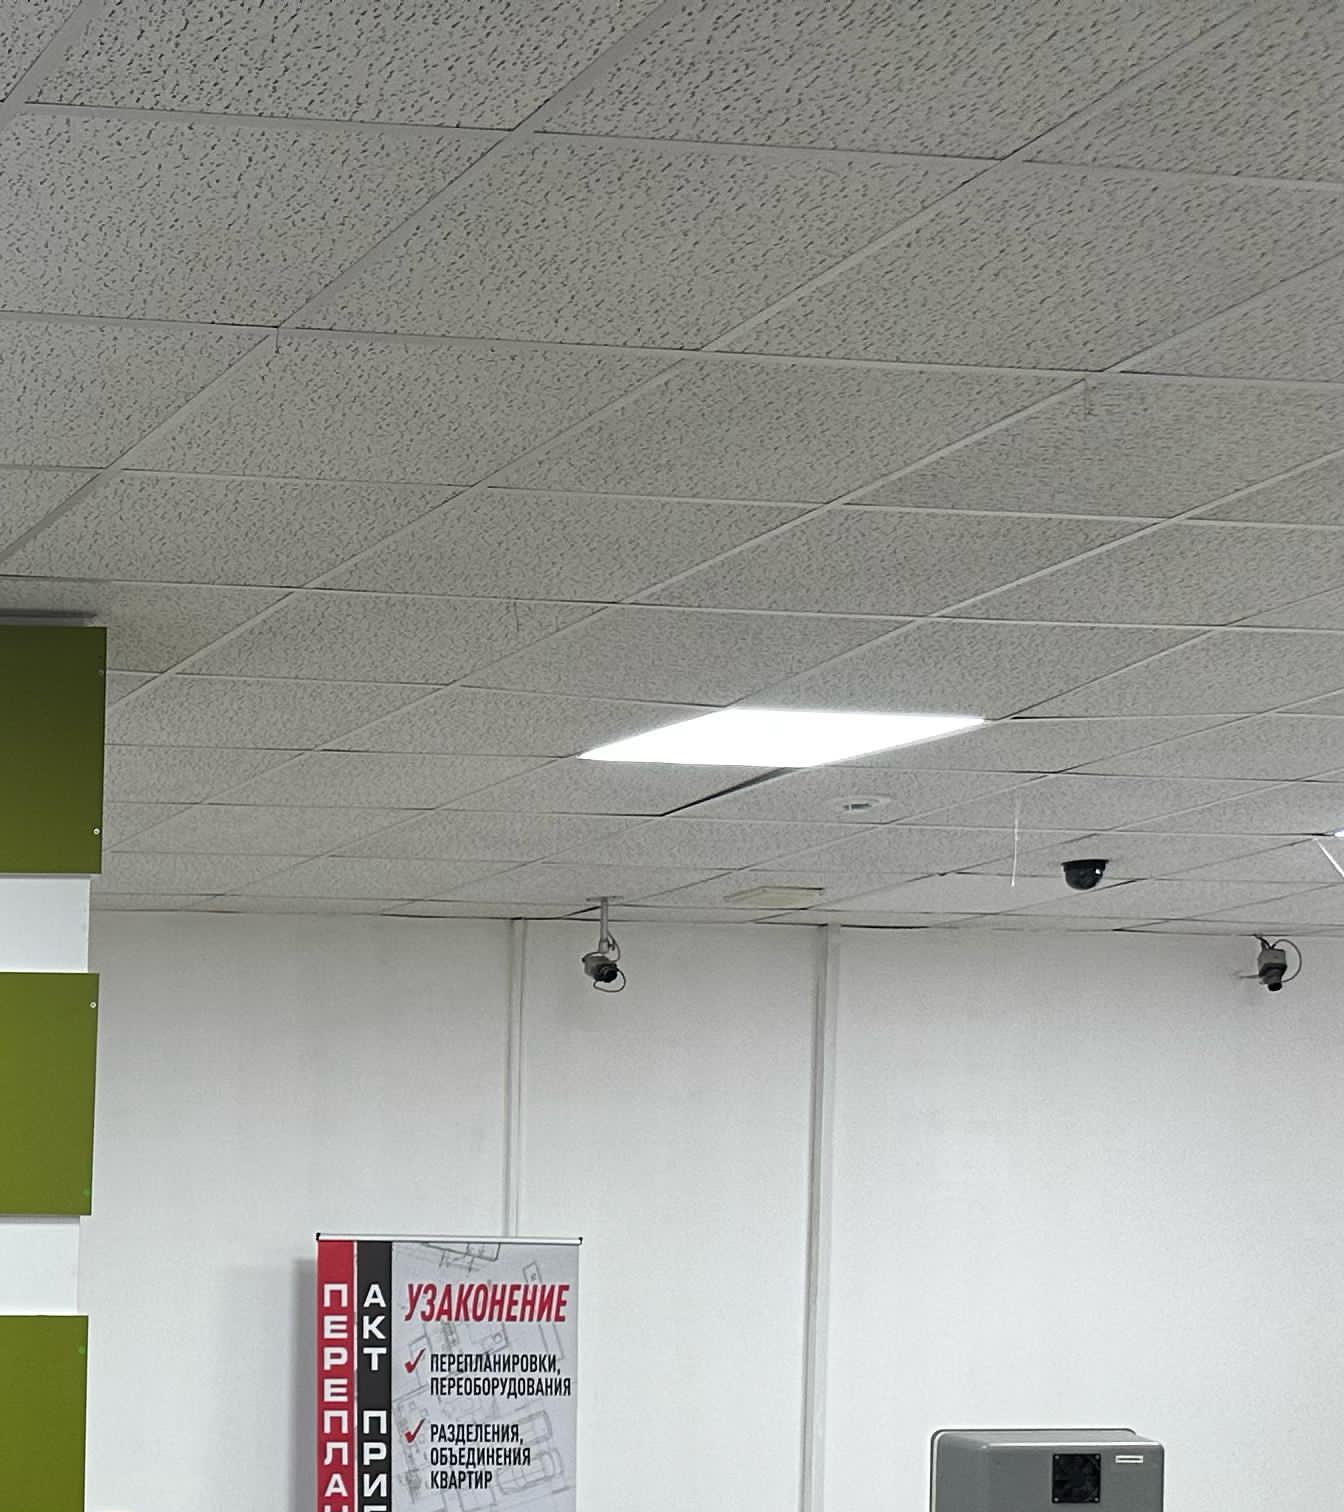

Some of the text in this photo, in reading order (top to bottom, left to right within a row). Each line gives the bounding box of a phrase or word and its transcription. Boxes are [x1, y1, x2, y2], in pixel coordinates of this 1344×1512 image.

[404, 1283, 570, 1322] УЗАКОНЕНИЕ
[362, 1283, 388, 1371] АКТ
[430, 1353, 561, 1375] ПЕРЕПЛАНИРОВКИ,
[430, 1376, 571, 1399] ПЕРЕОБОРУДОВАНИЯ
[430, 1423, 524, 1445] РАЗДЕЛЕНИЯ,
[430, 1447, 531, 1469] ОБЪЕДИНЕНИЯ
[430, 1470, 493, 1489] КВАРТИР
